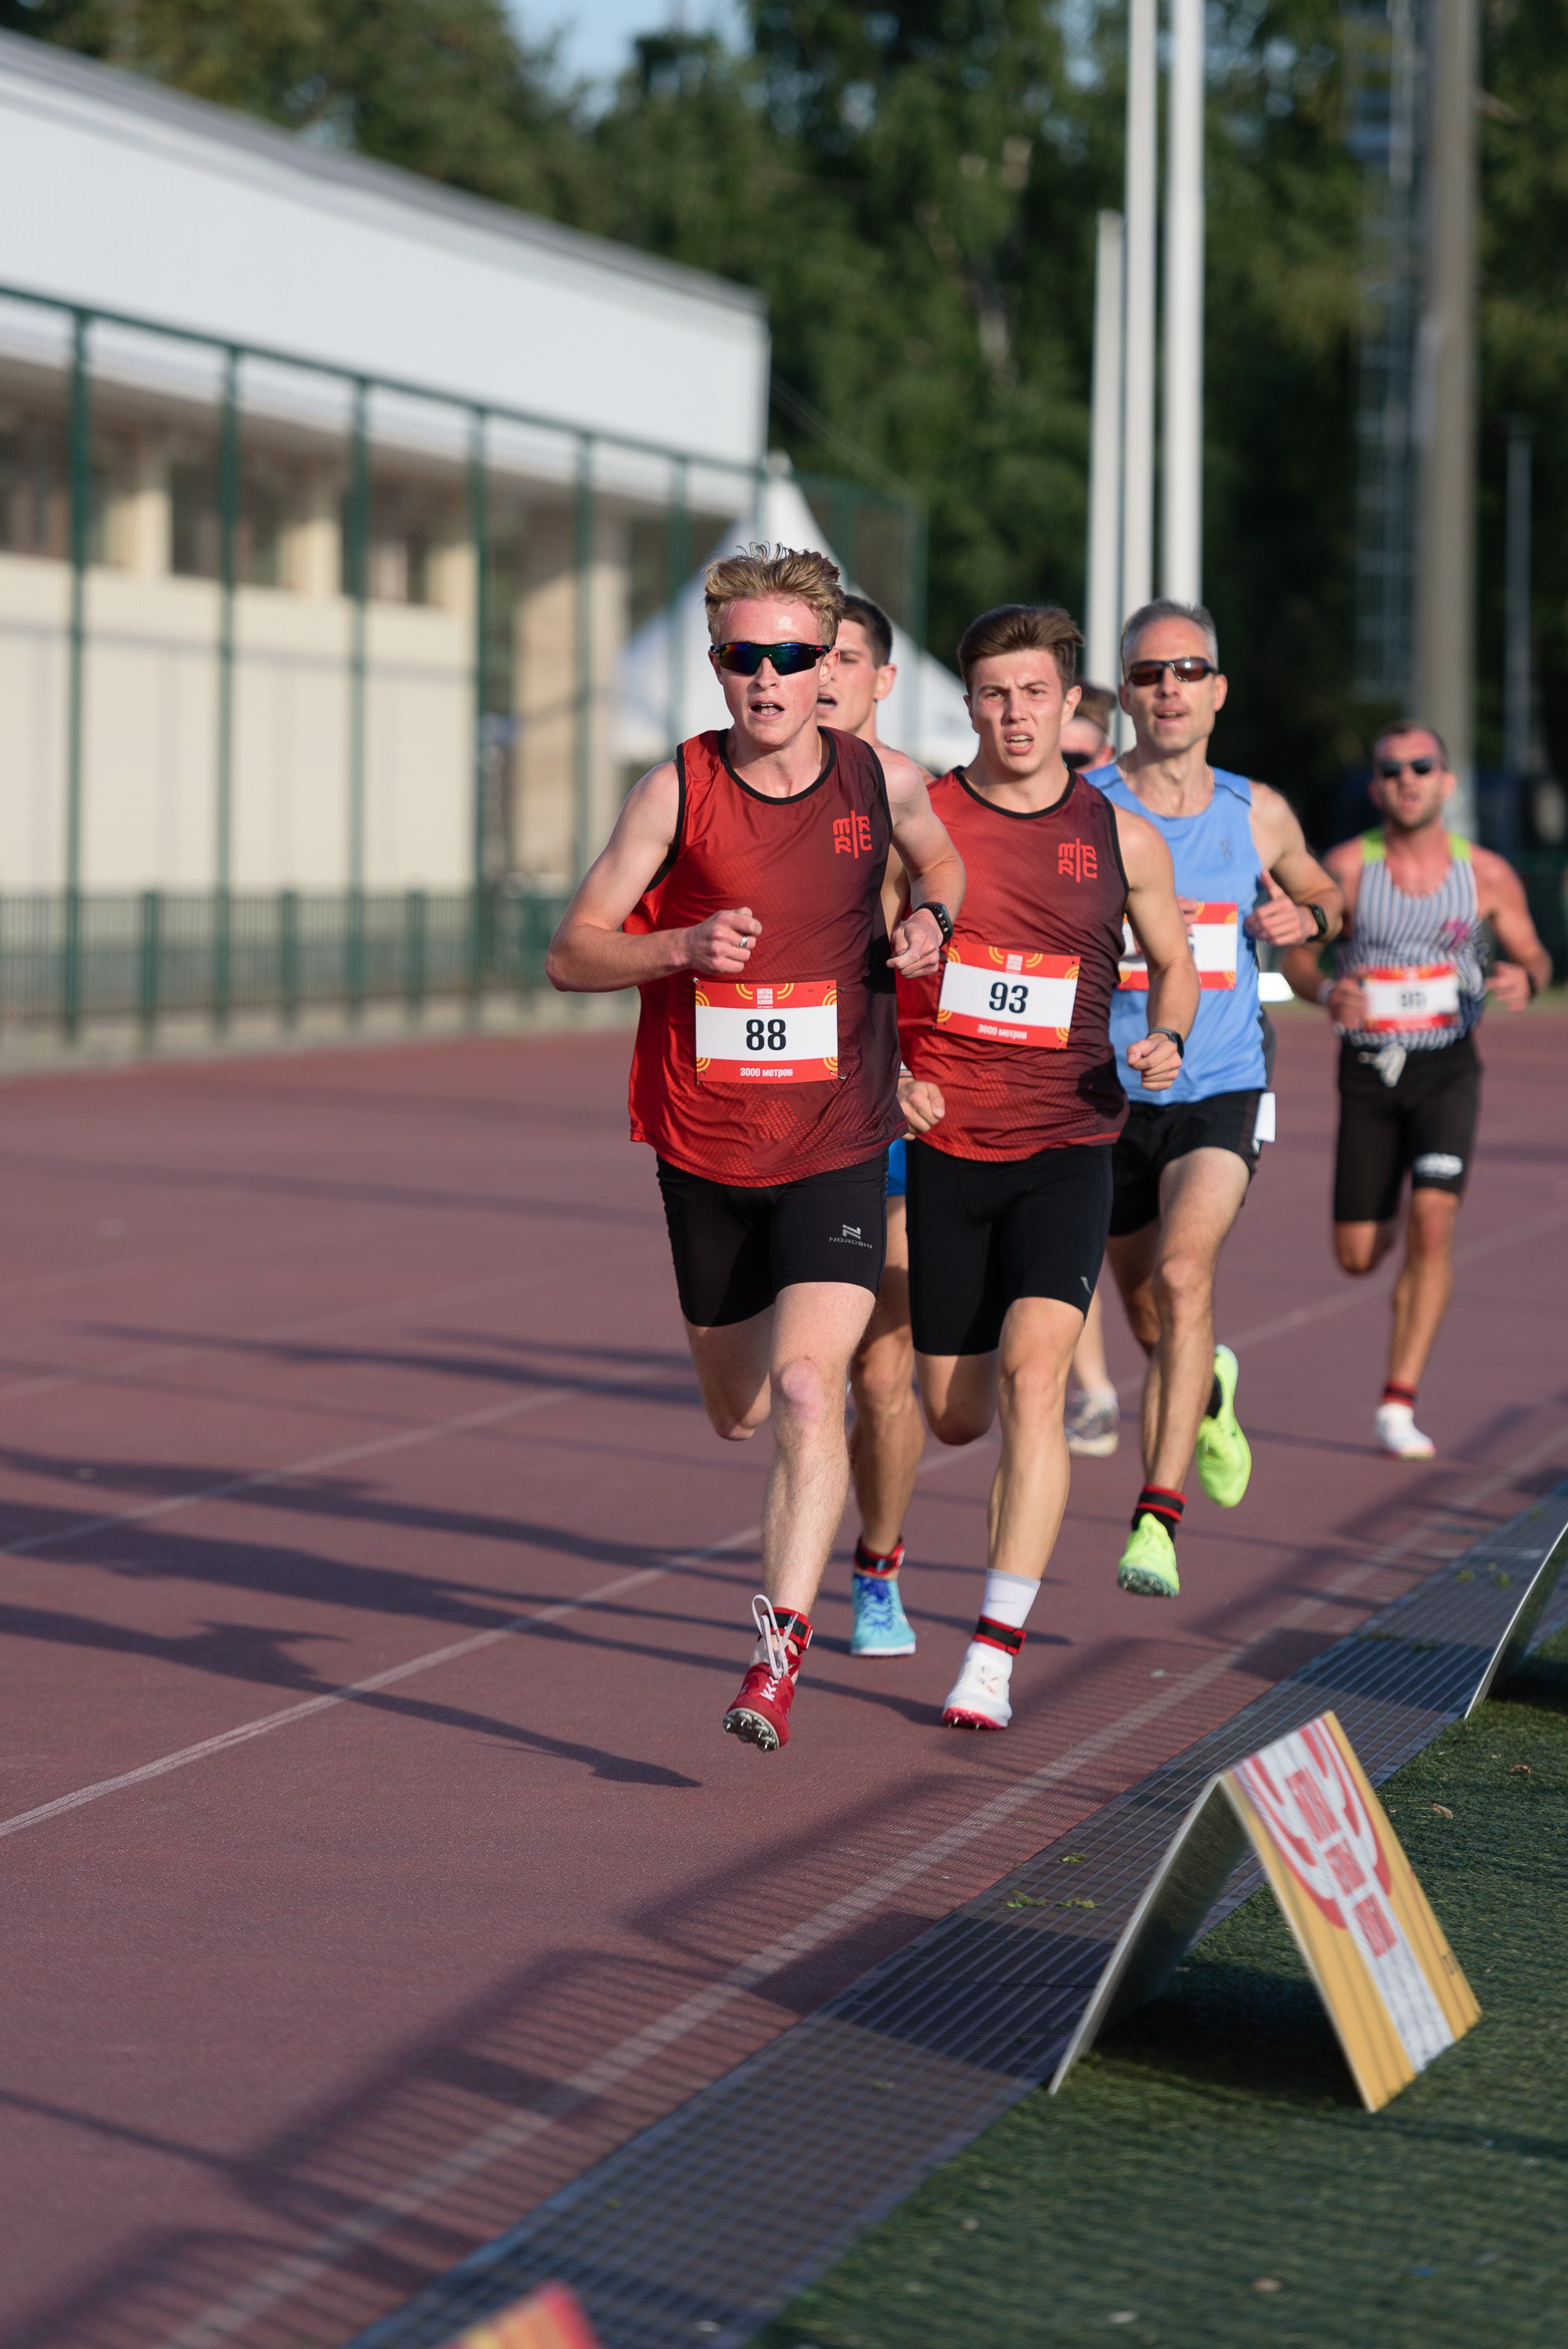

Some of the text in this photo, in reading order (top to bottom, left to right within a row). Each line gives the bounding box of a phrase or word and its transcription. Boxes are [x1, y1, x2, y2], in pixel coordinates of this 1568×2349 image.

[989, 982, 1029, 1014] 93
[746, 1019, 787, 1051] 88
[977, 1023, 998, 1036] 3000
[740, 1067, 794, 1078] 3000 метров
[829, 1237, 873, 1249] NORDSKI
